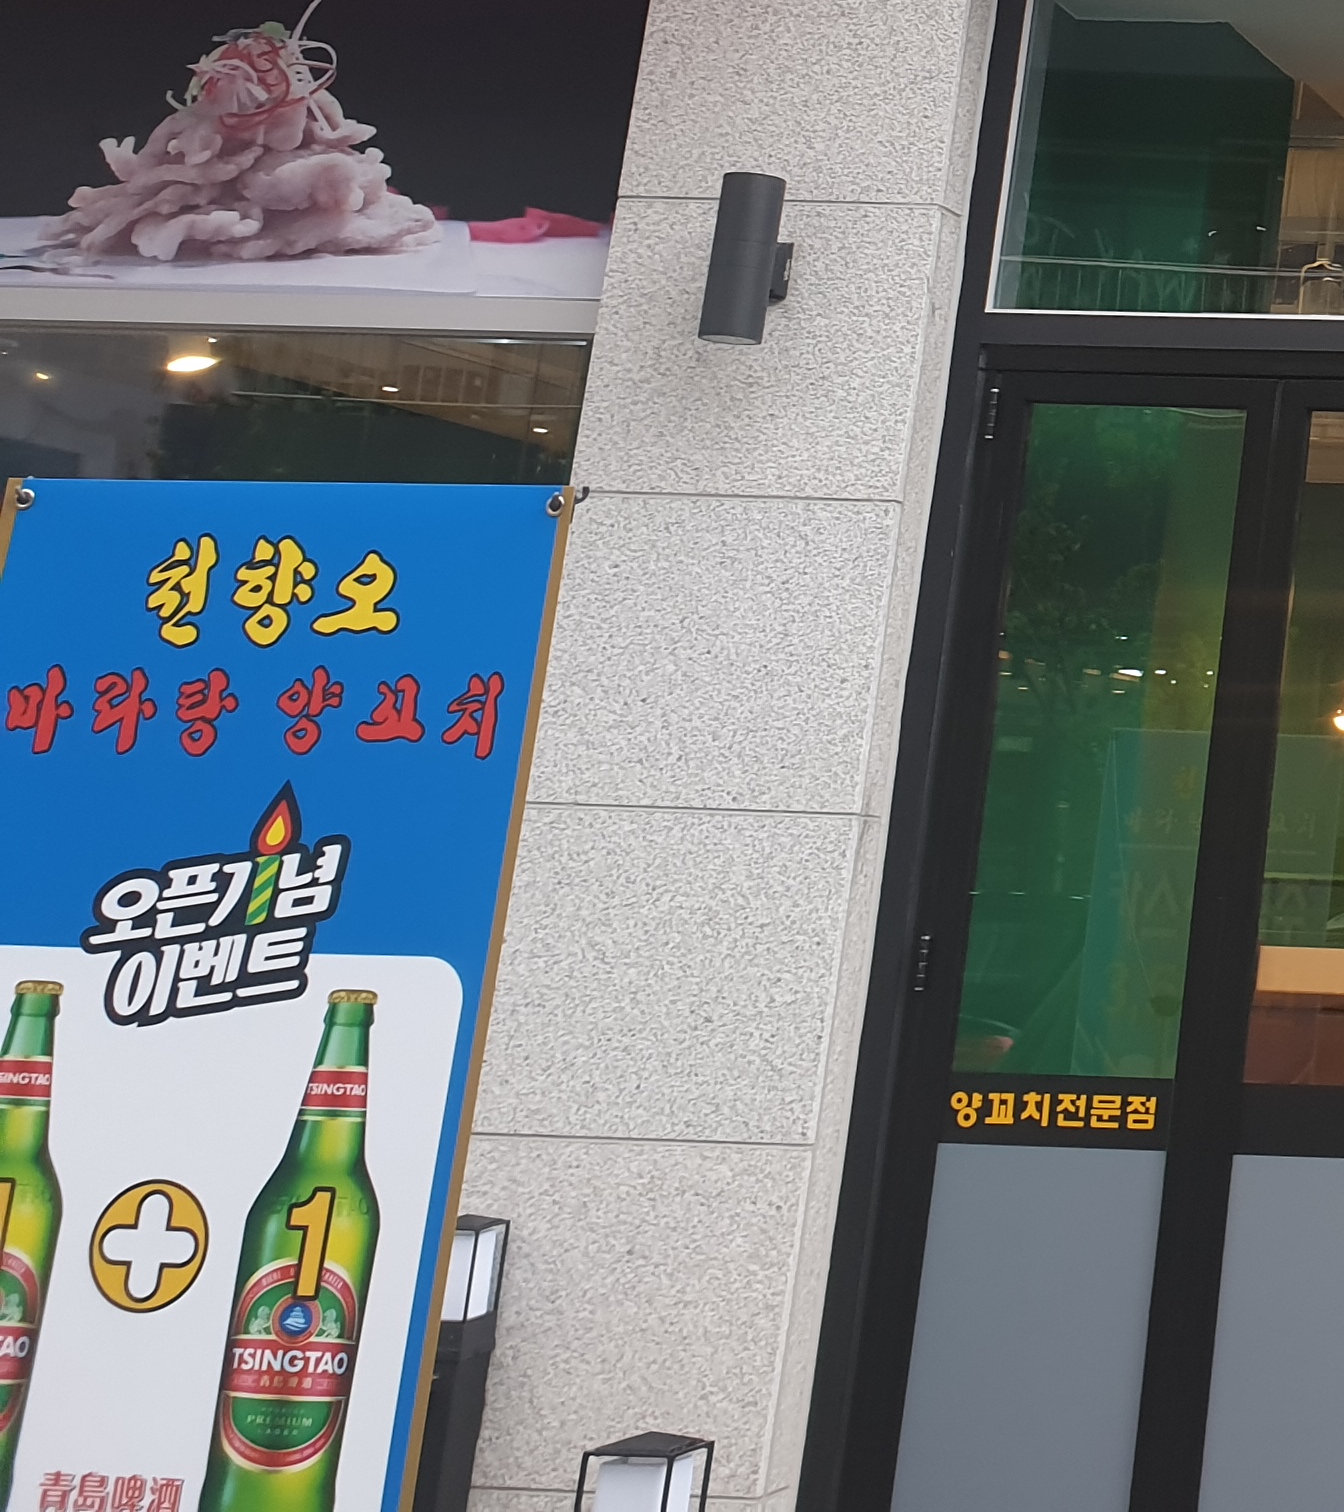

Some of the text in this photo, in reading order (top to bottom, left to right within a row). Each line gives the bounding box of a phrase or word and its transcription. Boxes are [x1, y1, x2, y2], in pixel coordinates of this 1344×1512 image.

[146, 533, 400, 648] 천향오
[5, 664, 505, 760] 마라탕 양꼬치
[88, 841, 344, 945] 오픈기념
[111, 926, 309, 1017] 이벤트
[307, 1083, 367, 1096] TSINGTAO
[949, 1090, 1158, 1131] 양꼬치전문점
[231, 1347, 349, 1376] TSINGTAO
